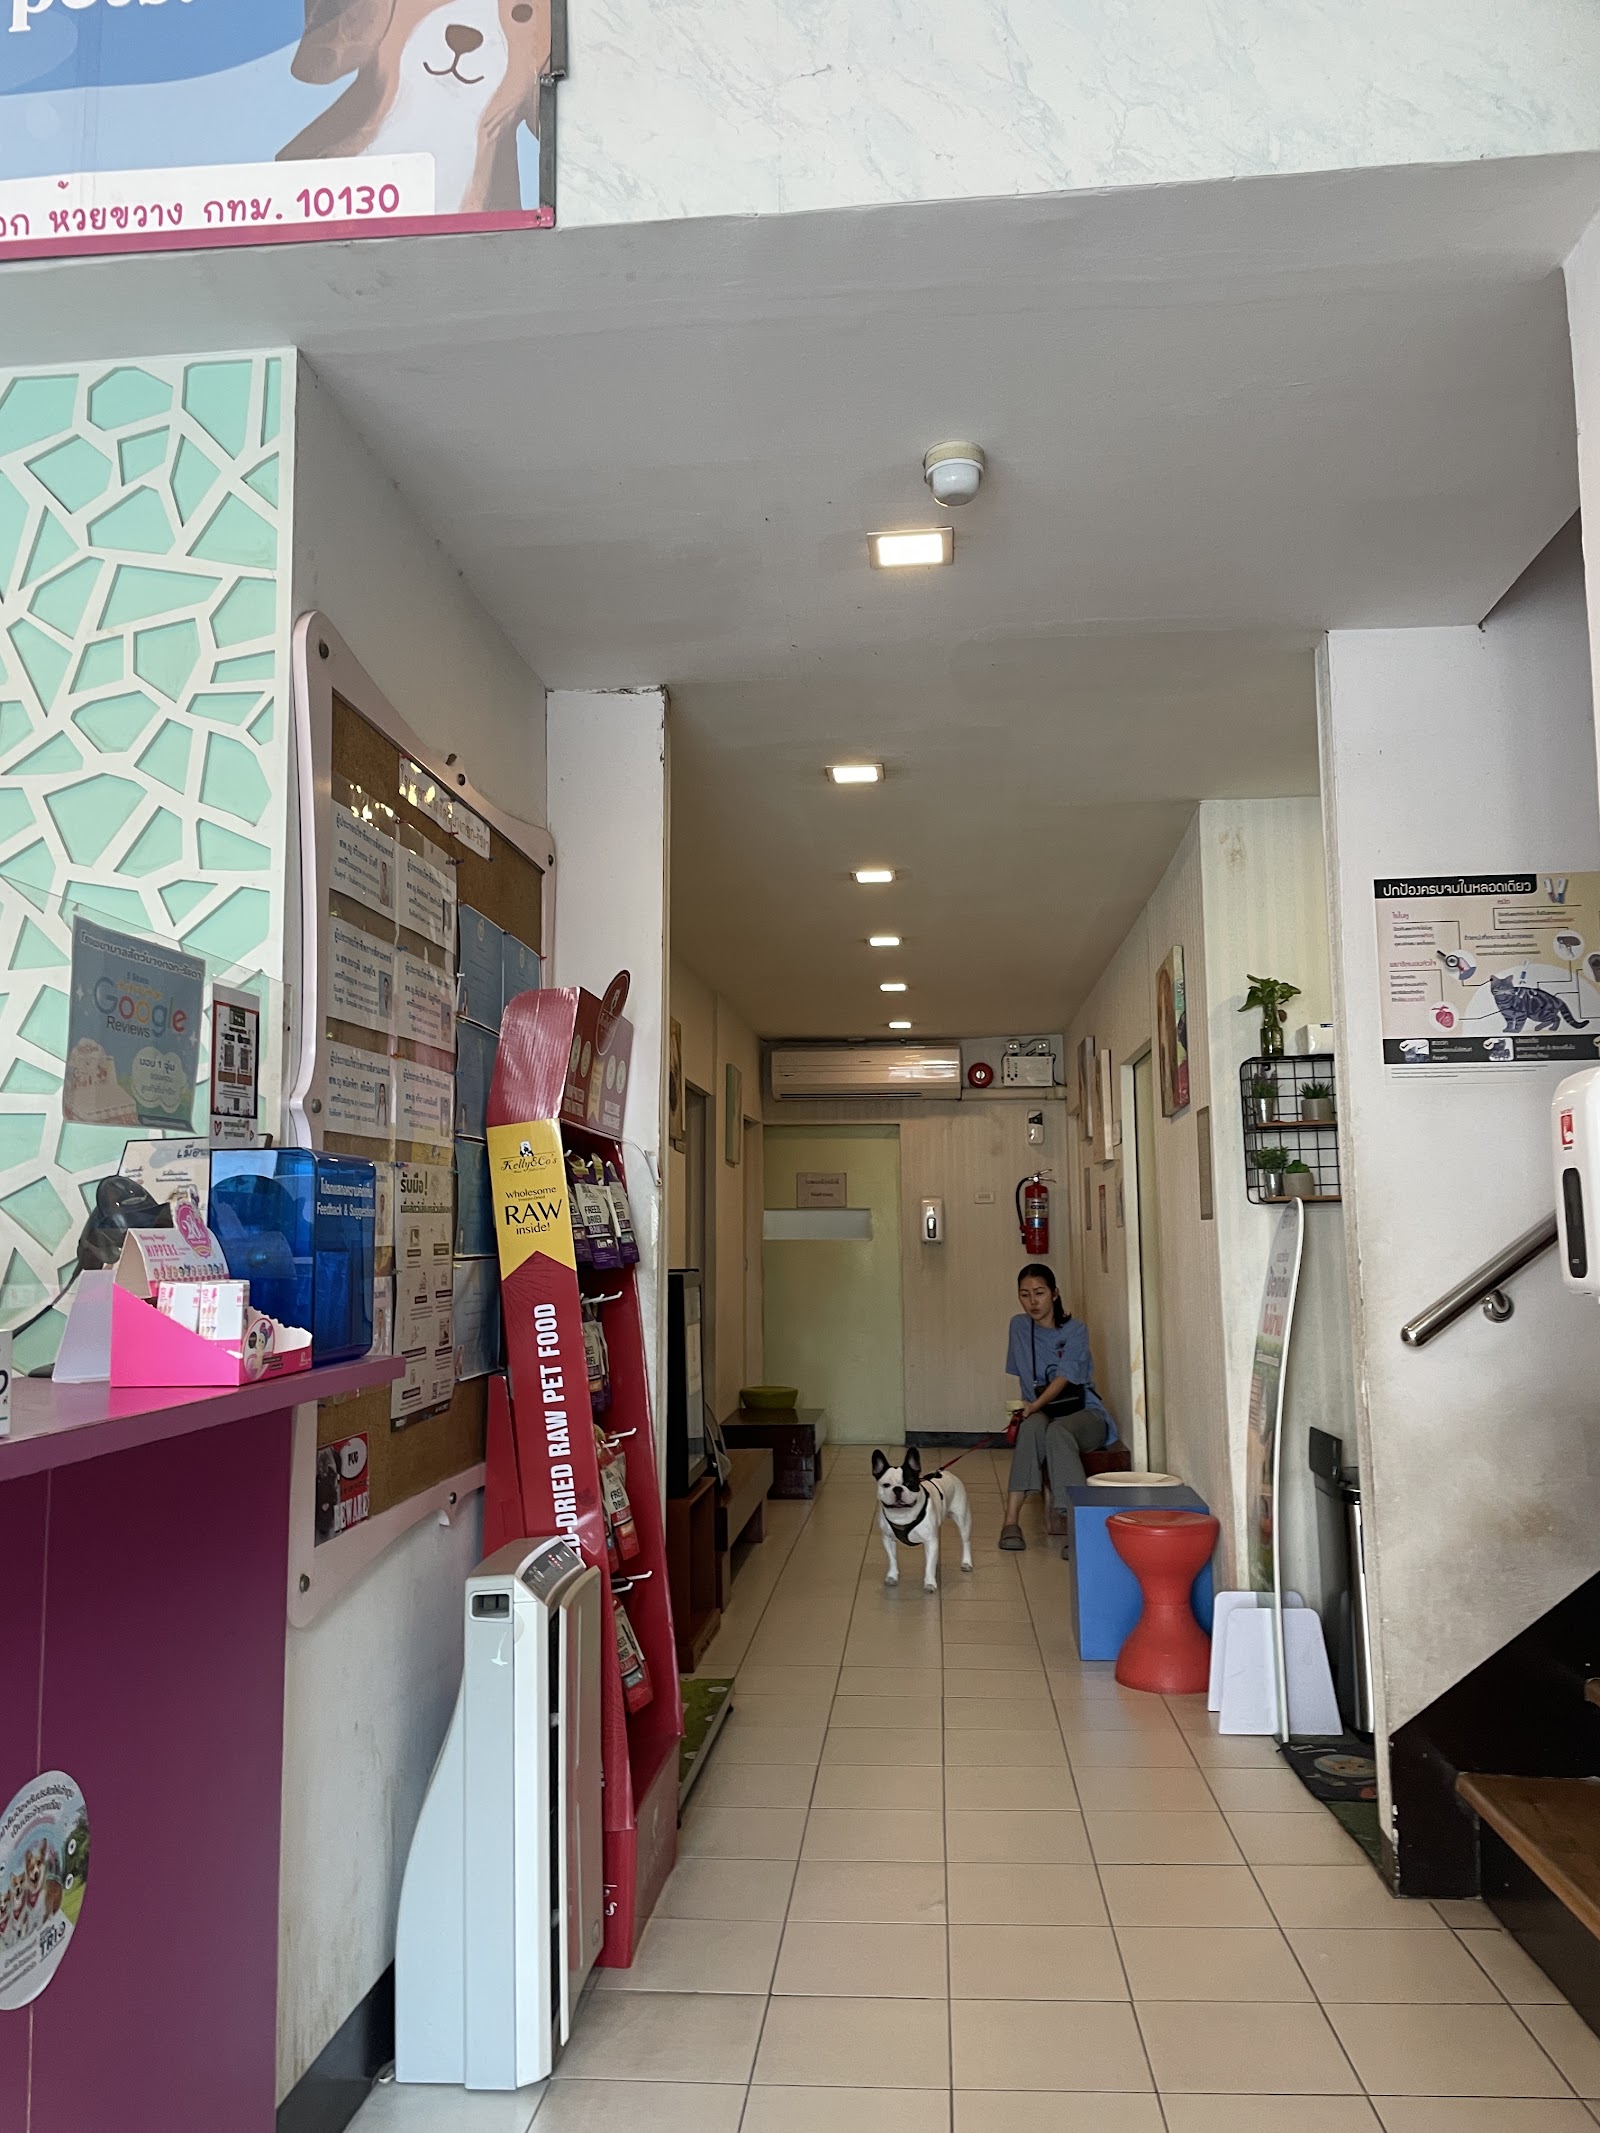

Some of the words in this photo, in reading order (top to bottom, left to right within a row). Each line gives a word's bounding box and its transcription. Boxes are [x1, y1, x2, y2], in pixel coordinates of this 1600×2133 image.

[49, 181, 183, 233] ห้วยขวาง
[203, 197, 282, 223] กทม.
[296, 183, 400, 217] 10130
[1383, 878, 1532, 897] ปกป้องครบจบในหลอดเดียว
[94, 976, 188, 1037] Google
[106, 1015, 151, 1039] Reviews
[400, 1171, 428, 1196] รับมือ!
[317, 1201, 342, 1216] Feedback
[343, 1203, 348, 1216] &
[504, 1199, 562, 1225] RAW
[516, 1222, 551, 1235] inside!
[534, 1303, 561, 1358] FOOD
[539, 1364, 565, 1404] PET
[544, 1410, 572, 1458] RAW
